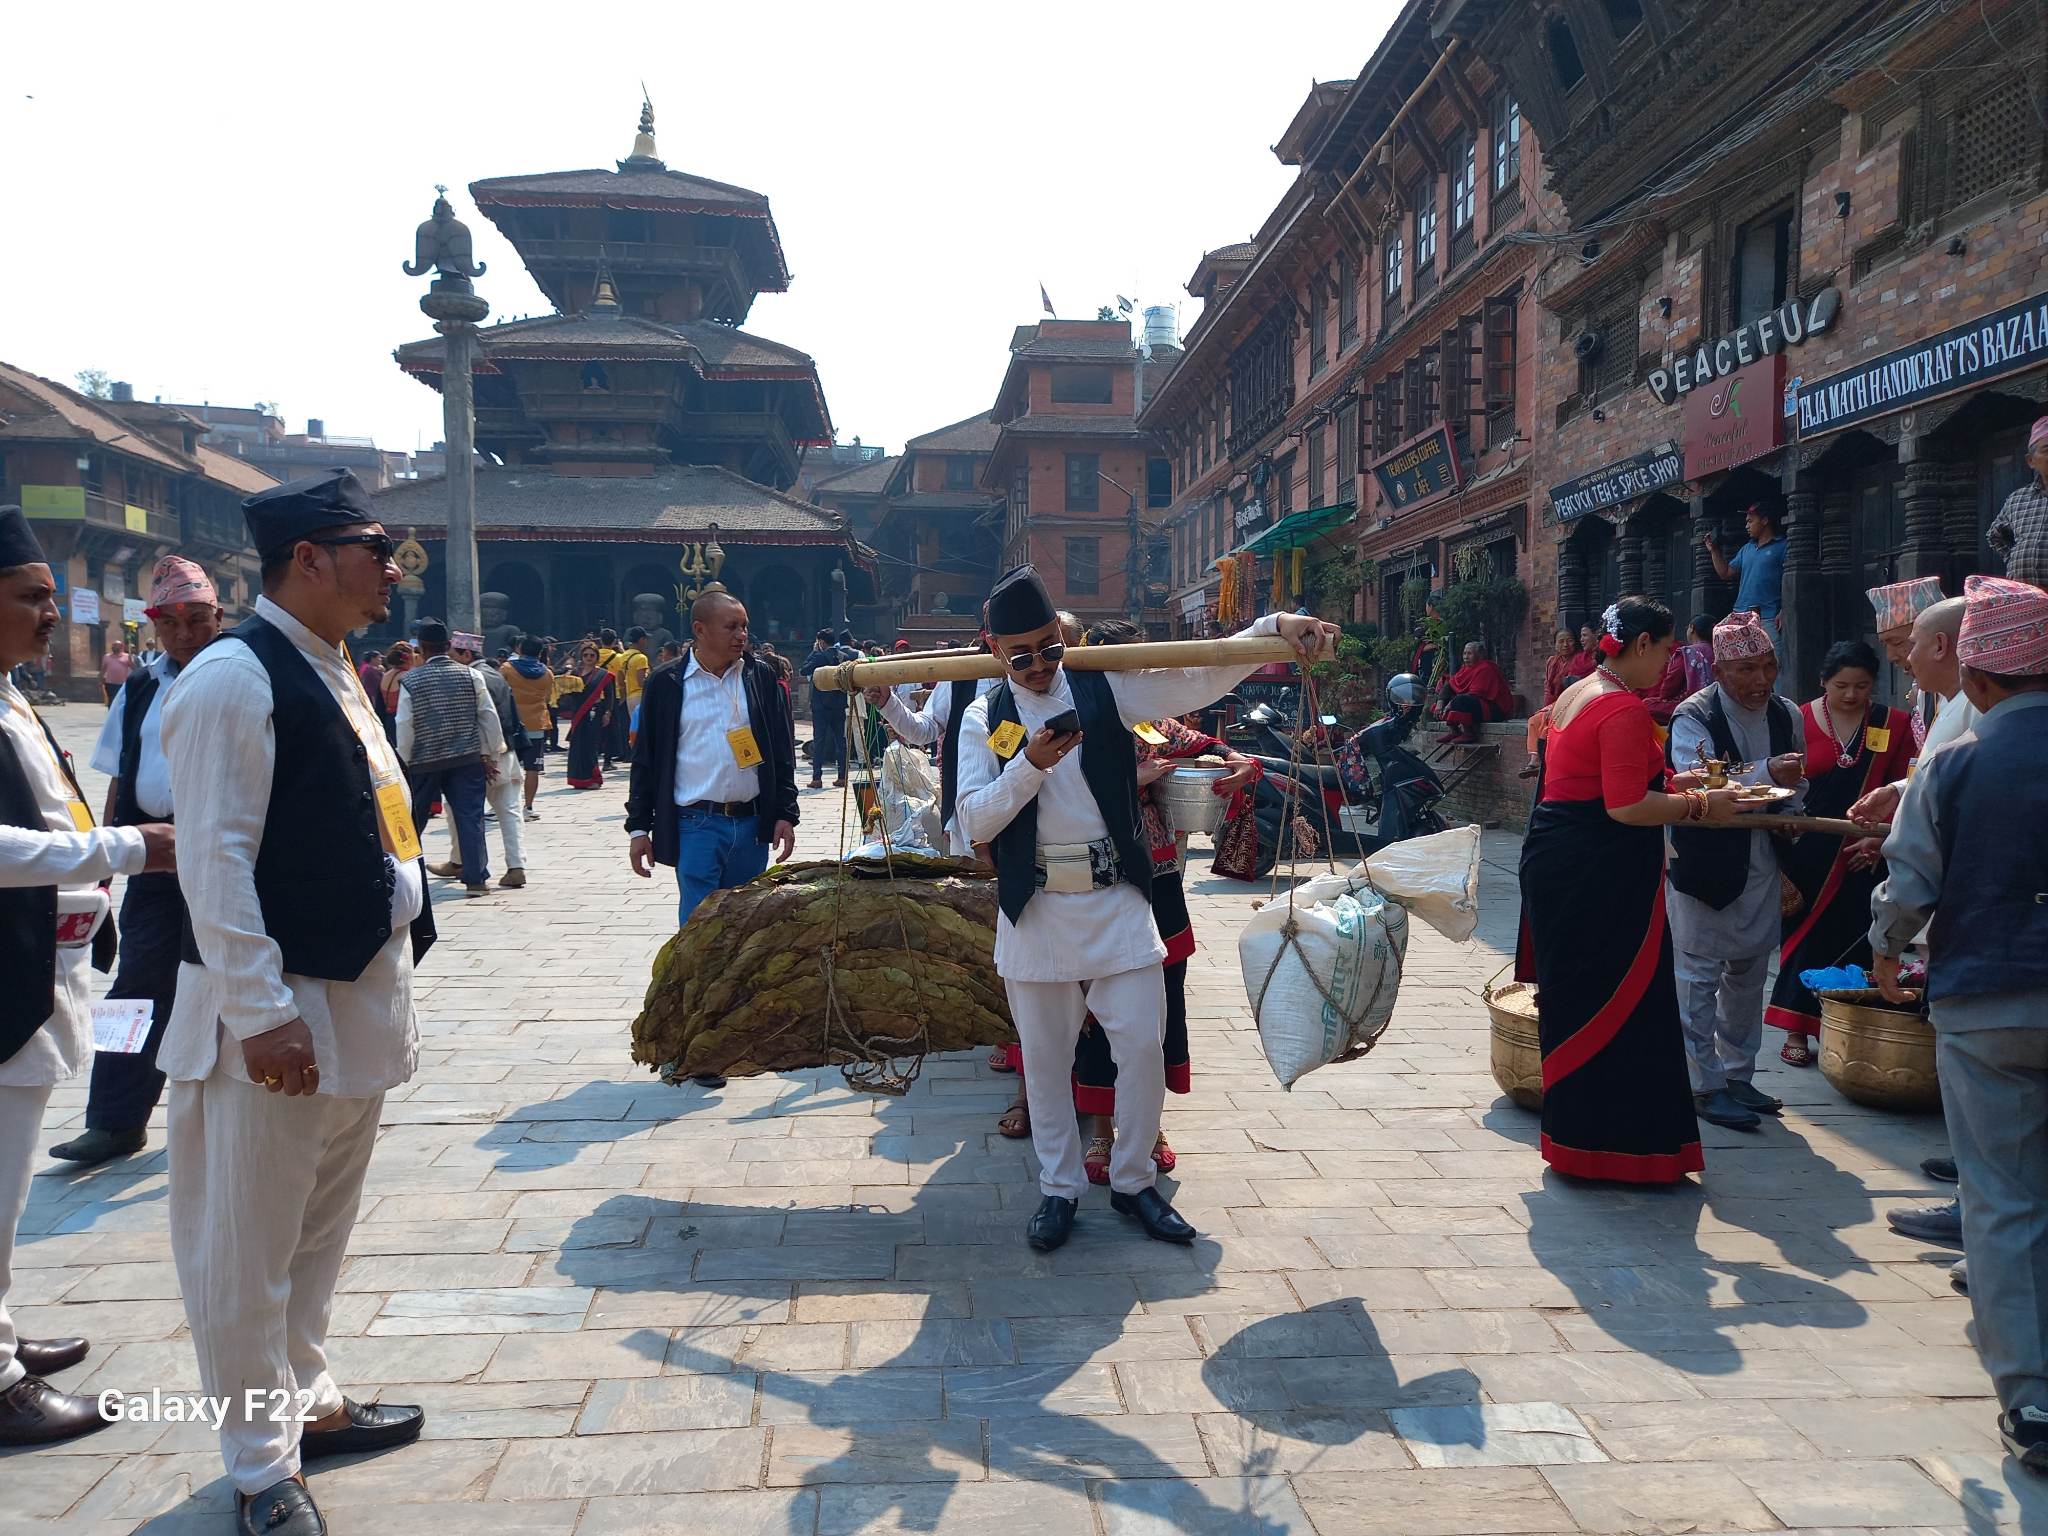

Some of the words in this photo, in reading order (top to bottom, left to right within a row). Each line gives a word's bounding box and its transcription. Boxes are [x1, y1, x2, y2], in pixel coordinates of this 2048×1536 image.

[1648, 294, 1826, 404] PEACEFUL
[1799, 388, 1829, 430] TAJA
[1828, 374, 1868, 420] MATH
[1868, 327, 1980, 407] HANDICRAFTS
[1417, 439, 1441, 462] COFFEE
[1554, 489, 1594, 516] PEACOCK
[1592, 483, 1612, 503] TEA
[1618, 468, 1650, 496] SPICE
[1648, 456, 1680, 483] SHOP
